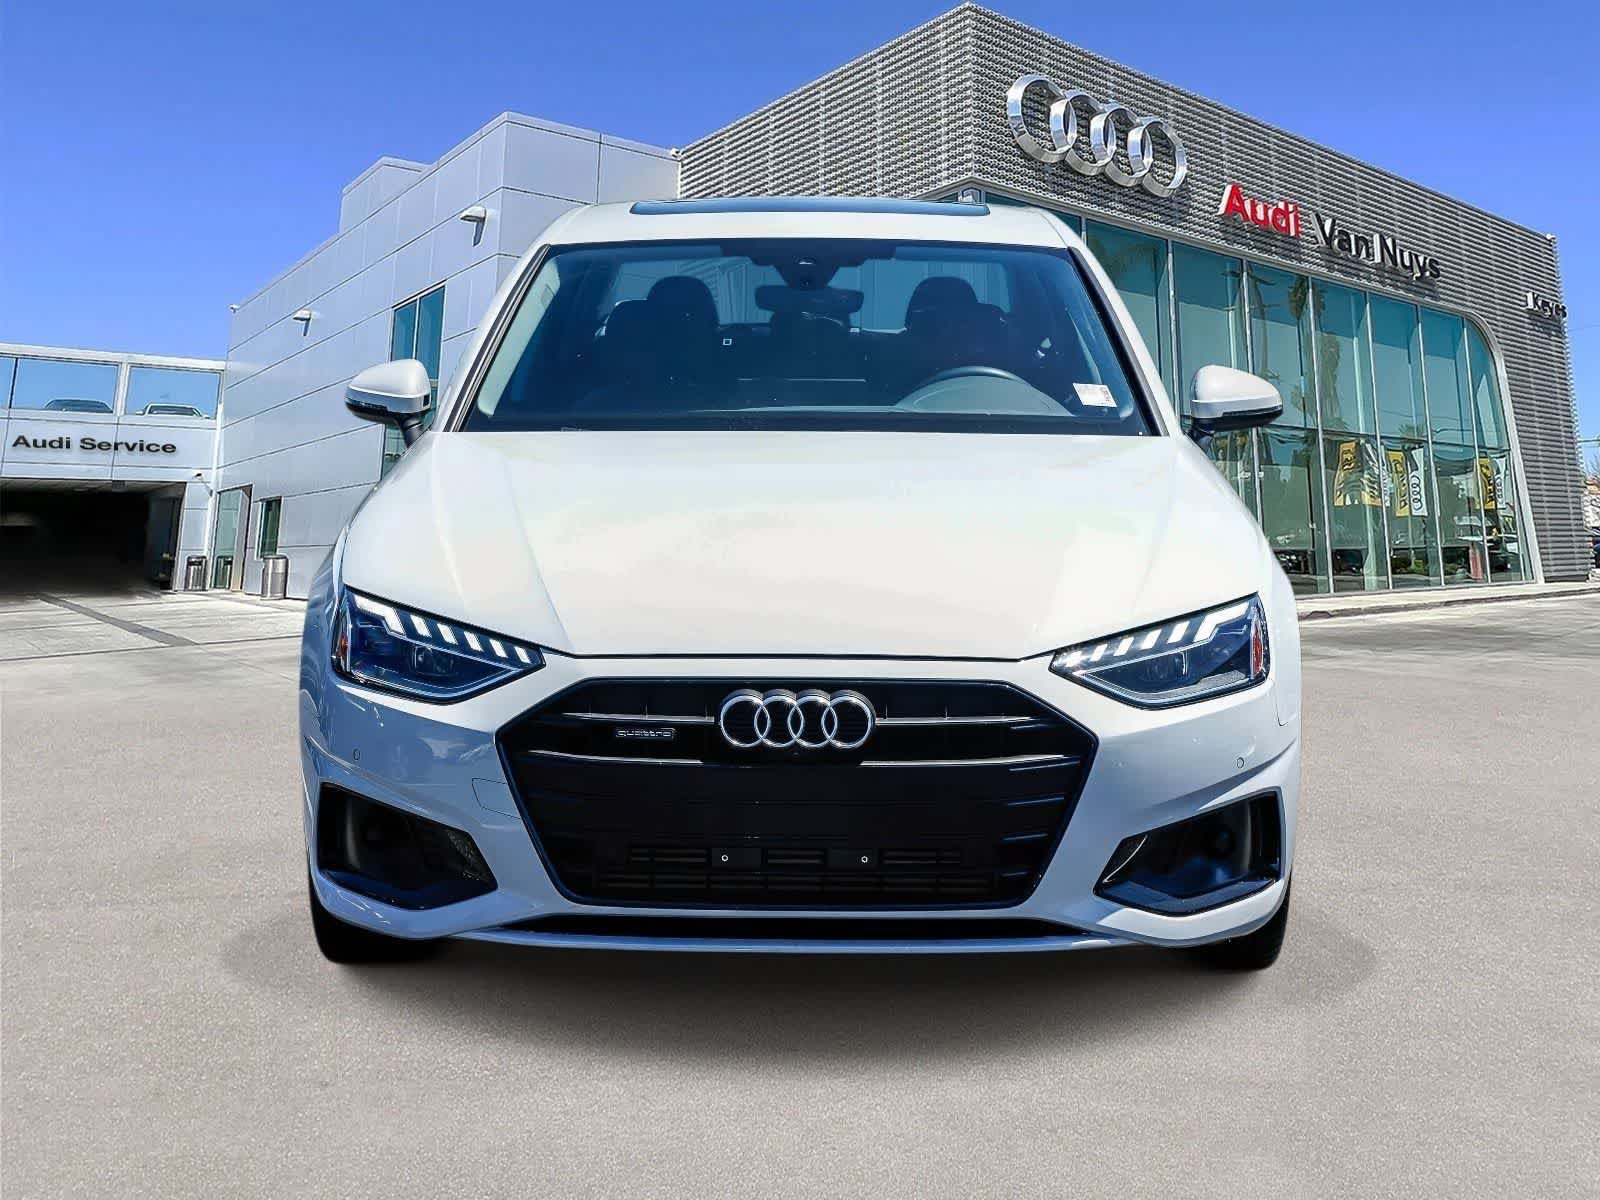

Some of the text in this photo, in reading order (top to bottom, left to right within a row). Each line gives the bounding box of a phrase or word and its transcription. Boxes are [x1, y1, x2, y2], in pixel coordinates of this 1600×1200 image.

[1217, 182, 1441, 281] Audi Van Nuys
[1525, 291, 1567, 319] Keyes
[12, 434, 177, 454] Audi Service
